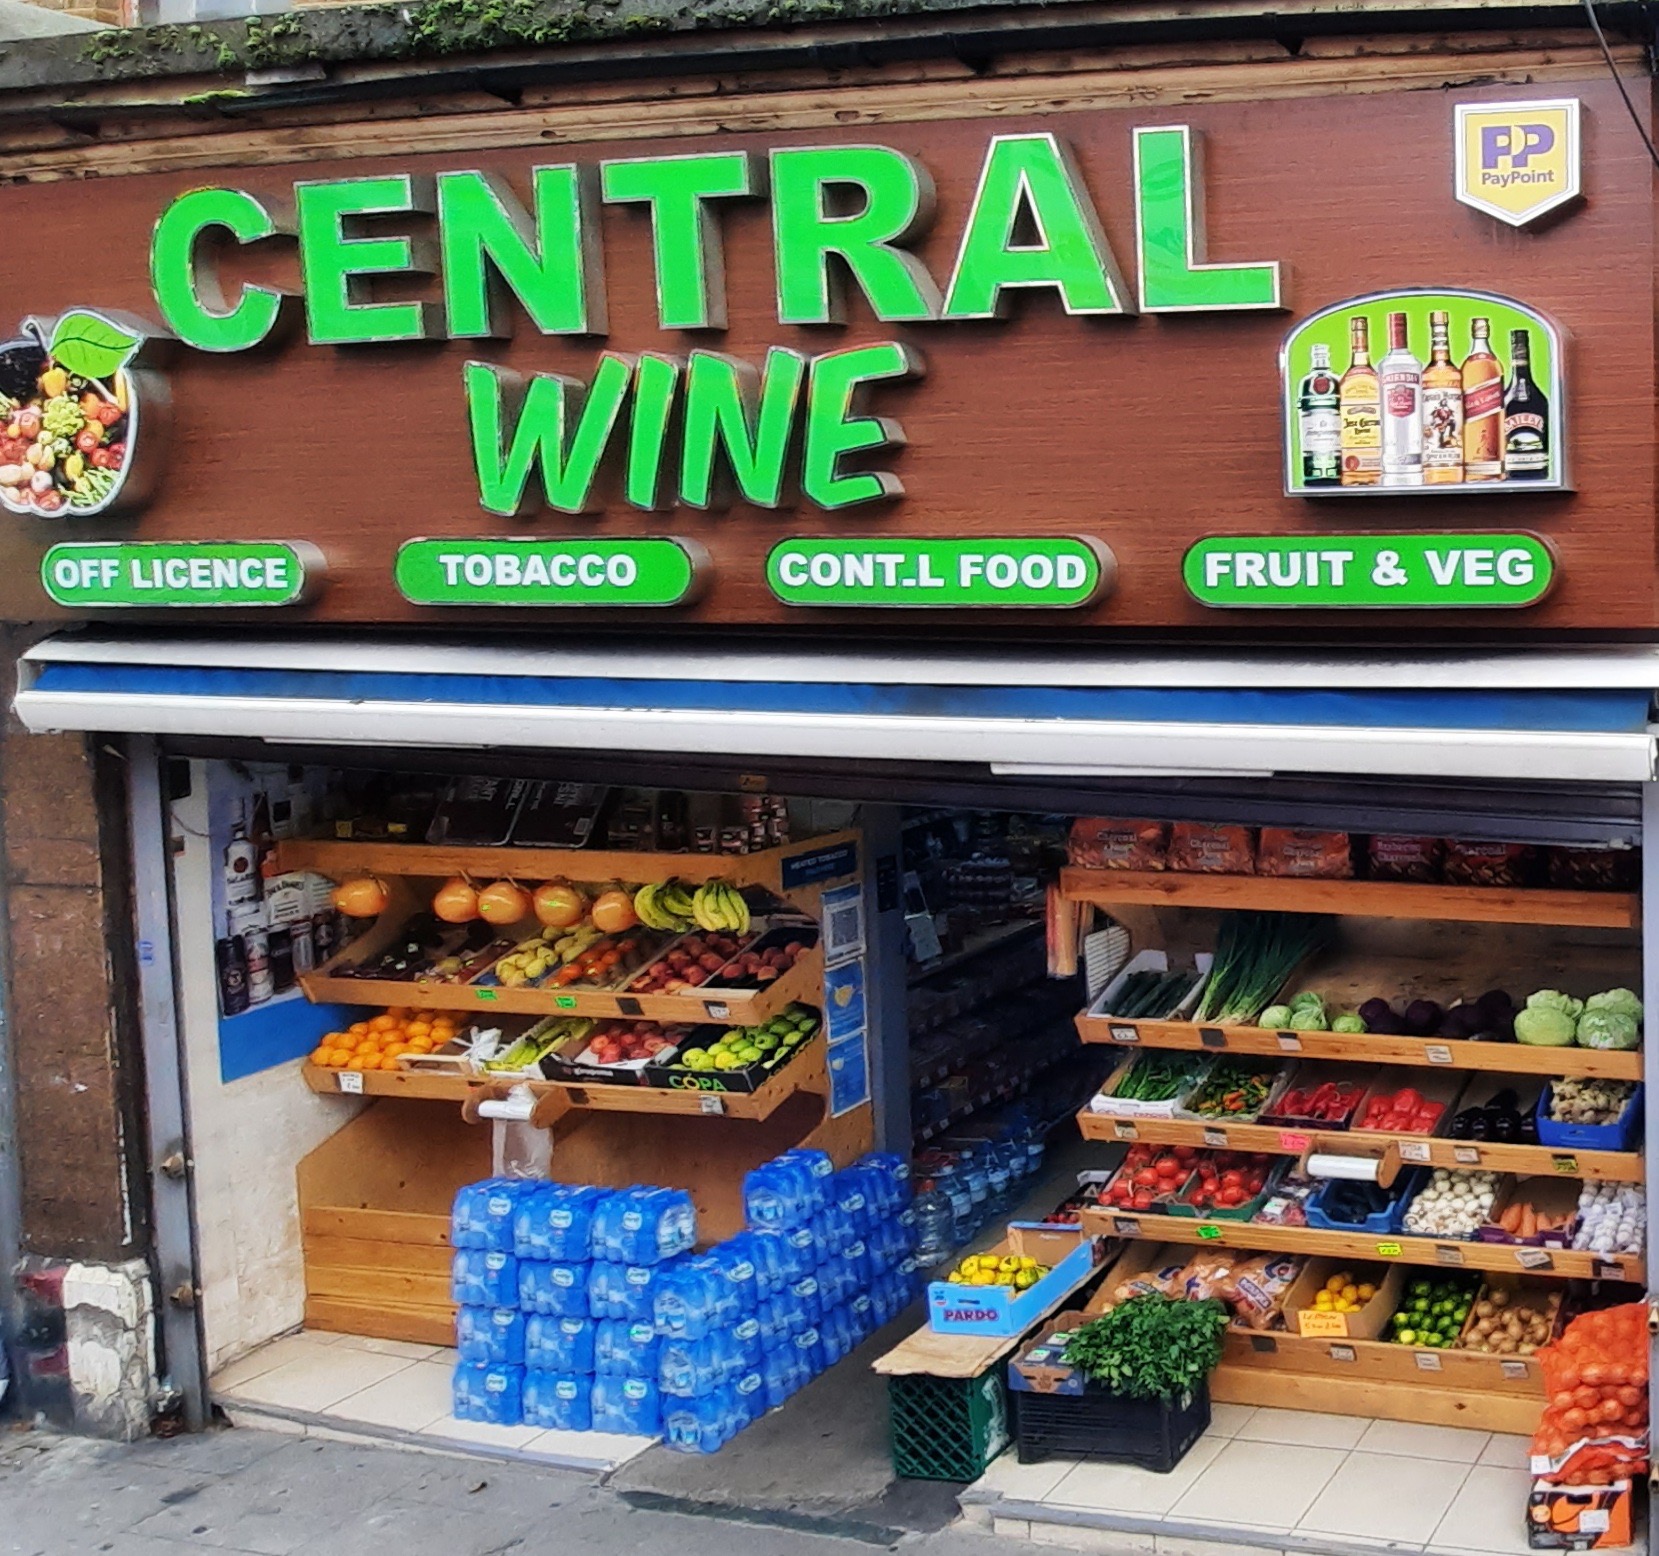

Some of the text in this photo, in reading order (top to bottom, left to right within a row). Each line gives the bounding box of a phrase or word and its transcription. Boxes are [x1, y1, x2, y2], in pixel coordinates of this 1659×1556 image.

[1482, 169, 1554, 188] PayPoint
[150, 125, 1282, 352] CENTRAL
[464, 342, 909, 517] WINE
[54, 557, 289, 589] OFF LICENCE
[438, 553, 637, 587] TOBACCO
[959, 553, 1087, 589] FOOD
[1205, 549, 1534, 587] FRUIT & VEG
[943, 1308, 999, 1322] PARDO
